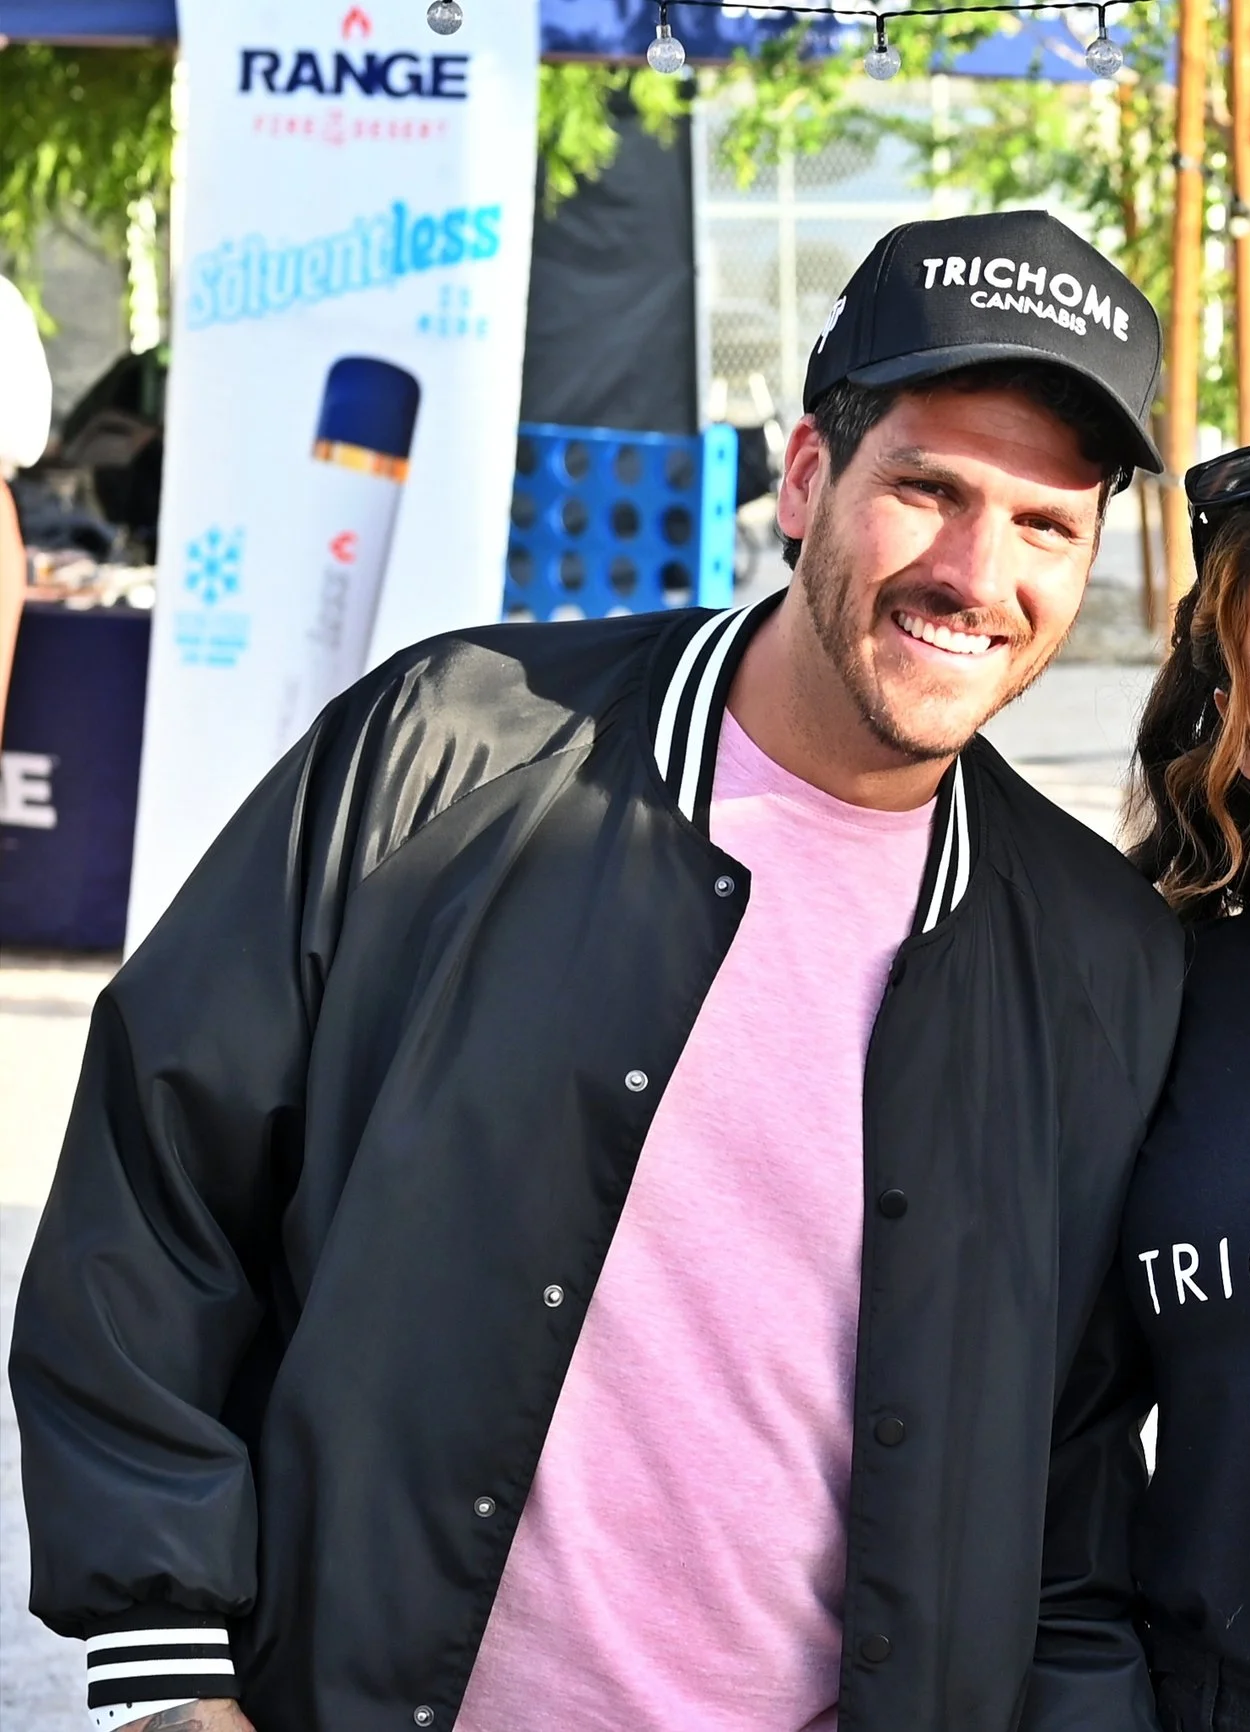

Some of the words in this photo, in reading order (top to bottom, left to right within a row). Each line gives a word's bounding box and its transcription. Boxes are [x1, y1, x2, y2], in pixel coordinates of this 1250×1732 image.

[238, 49, 470, 99] RANGE
[922, 256, 1129, 341] TRICHOME
[970, 291, 1087, 336] CANNABIS
